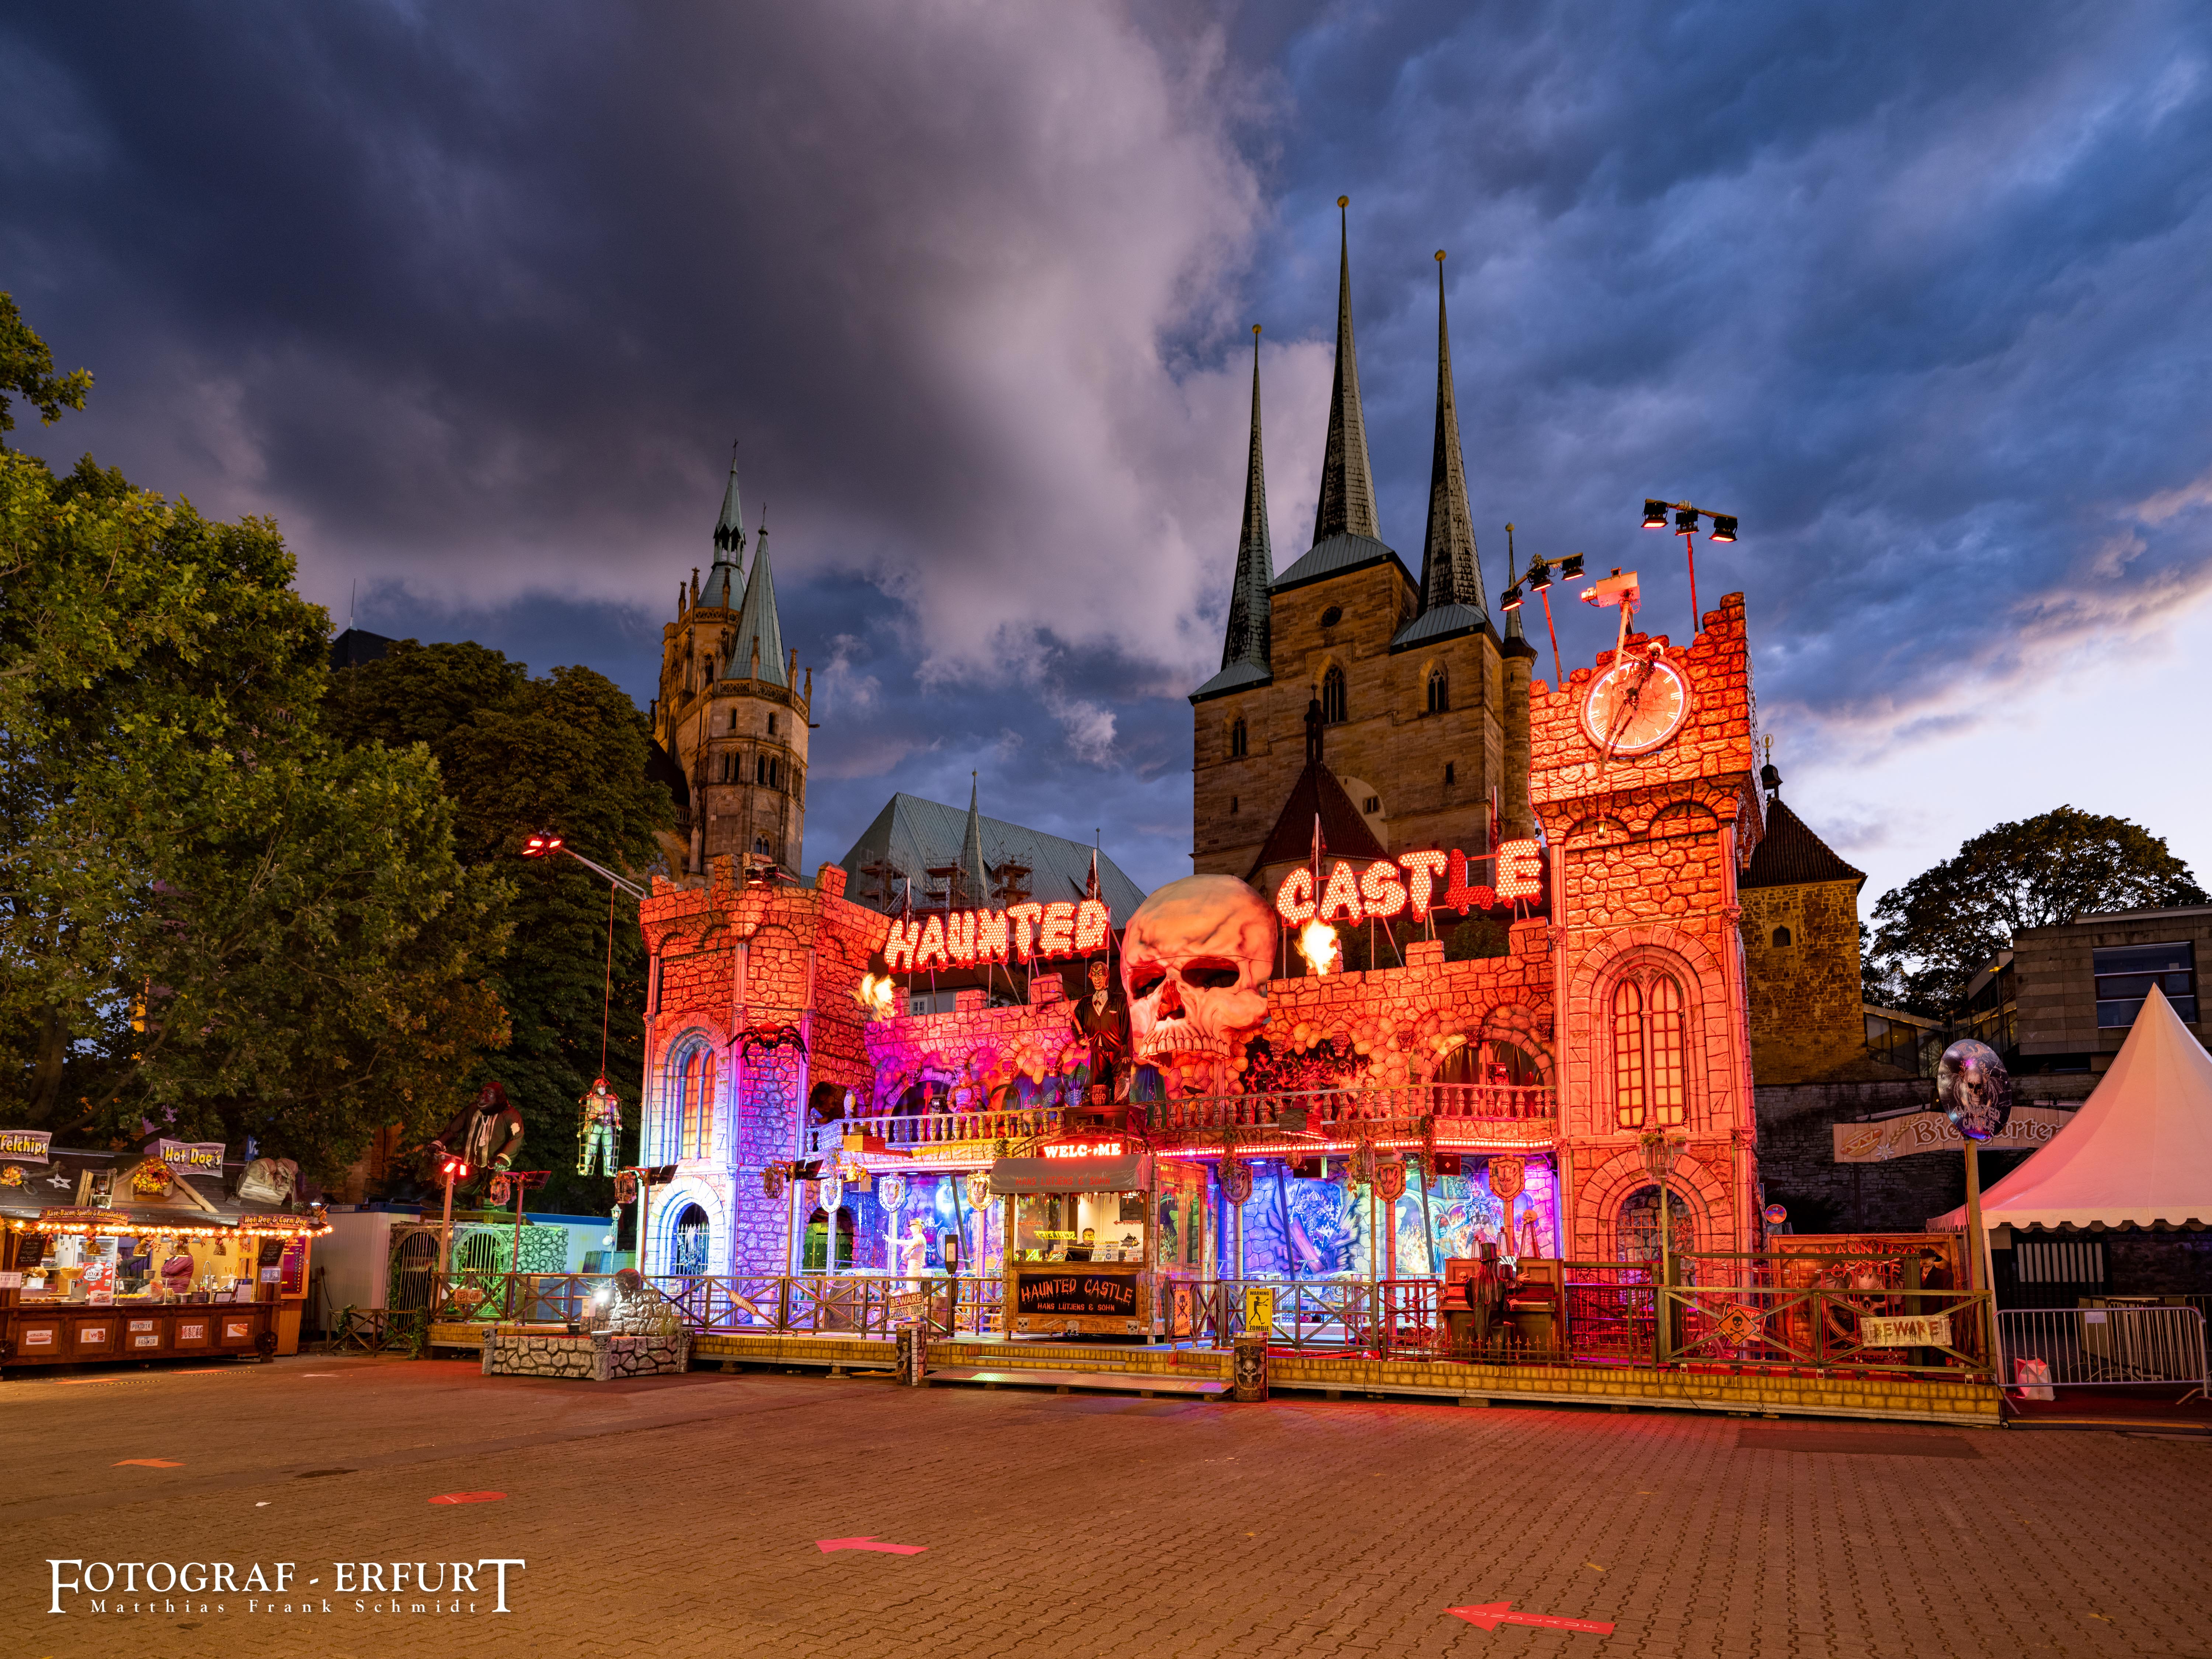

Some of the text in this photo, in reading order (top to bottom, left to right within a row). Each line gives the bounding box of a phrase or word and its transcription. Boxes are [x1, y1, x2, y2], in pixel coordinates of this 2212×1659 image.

[885, 839, 1543, 974] HAUNTED CASTLE
[164, 1146, 186, 1164] Hot
[1016, 1176, 1036, 1187] HANS
[1078, 1176, 1084, 1186] &
[1089, 1176, 1111, 1187] SOHN
[97, 1210, 128, 1221] Kartoffelchips
[258, 1215, 271, 1225] Dog
[279, 1216, 293, 1224] Corn
[295, 1217, 307, 1225] Dog
[1021, 1278, 1133, 1304] HAUNTED CASTLE
[730, 1291, 757, 1315] WARNING
[890, 1294, 921, 1307] BEWARE
[1058, 1302, 1085, 1311] LÜTJENS
[911, 1304, 923, 1315] ZONE
[1176, 1321, 1189, 1332] DANGER
[1873, 1321, 1938, 1341] BEWARE
